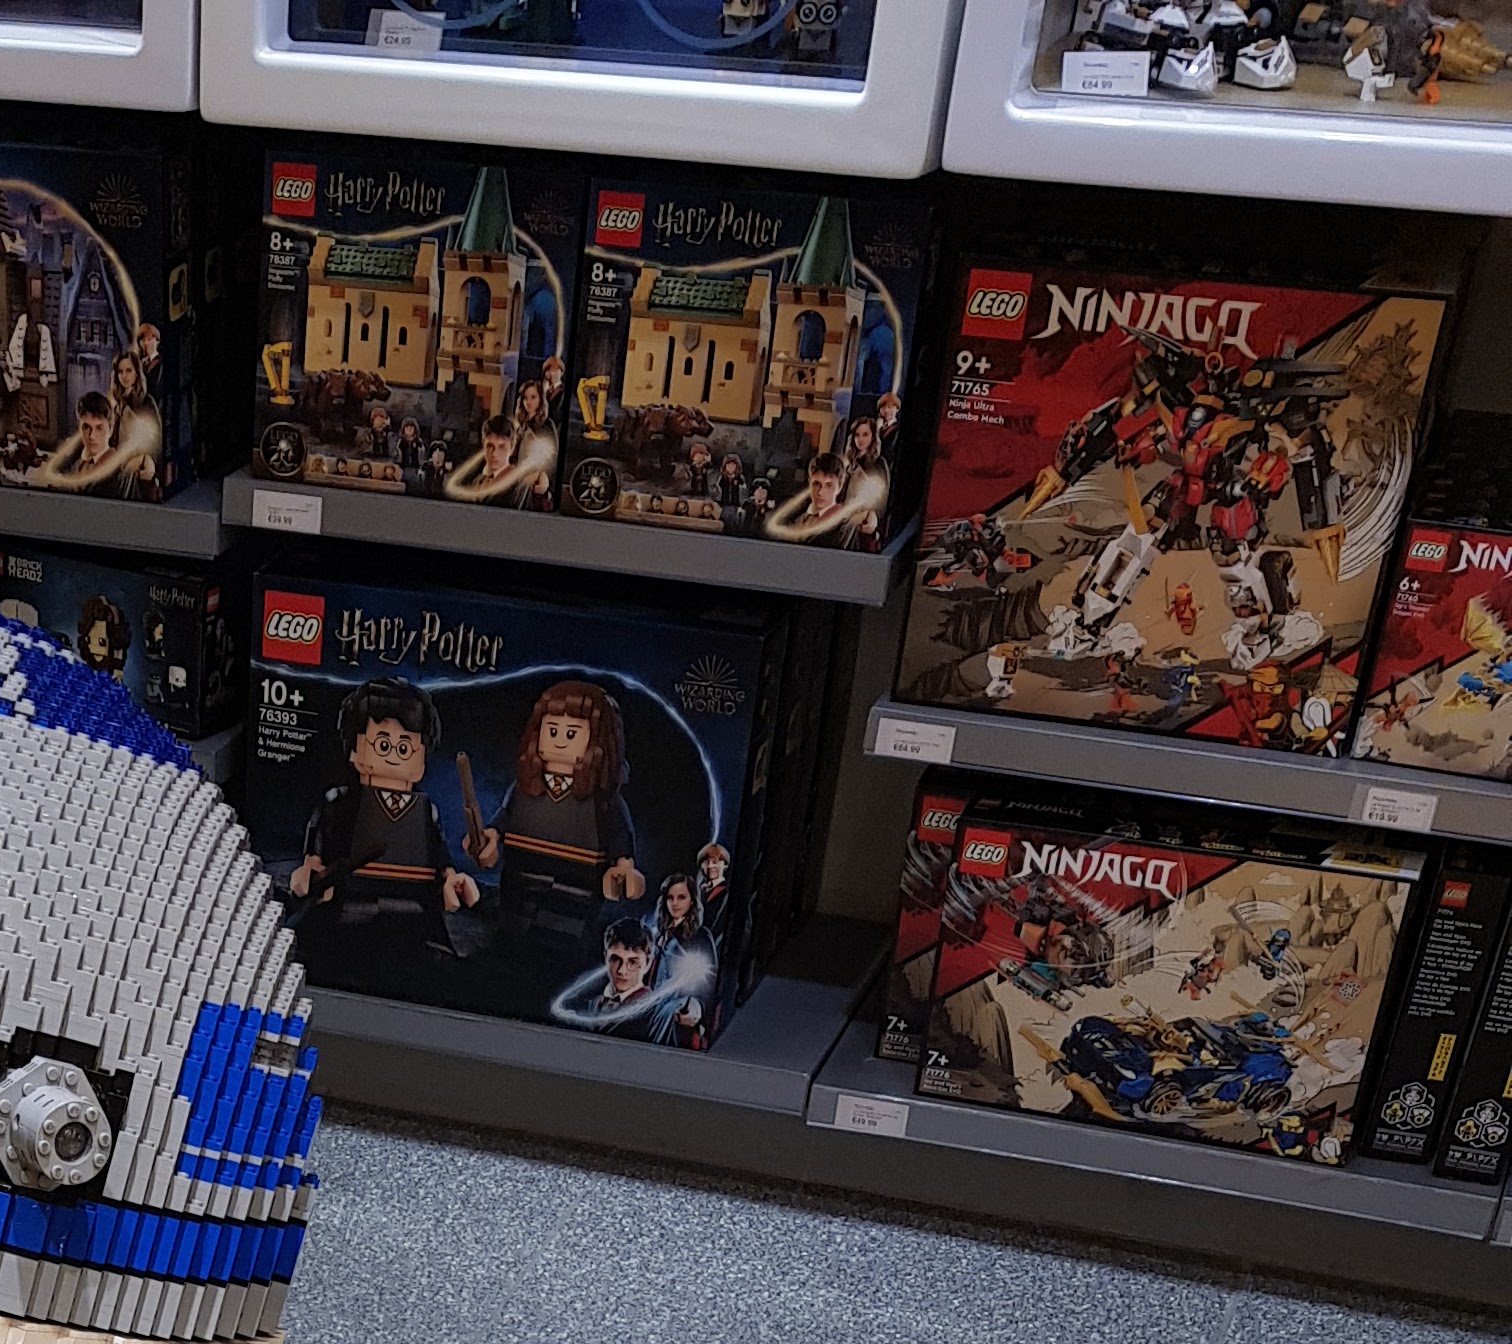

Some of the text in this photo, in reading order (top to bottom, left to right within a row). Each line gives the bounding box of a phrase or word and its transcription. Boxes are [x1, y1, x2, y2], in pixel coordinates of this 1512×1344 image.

[275, 178, 314, 200] LEGO
[324, 171, 445, 217] Harry Potter
[599, 207, 641, 230] LEGO
[652, 201, 782, 247] Harry Potter
[270, 232, 294, 251] 8+
[591, 263, 617, 283] 8+
[966, 289, 1026, 319] LEGO
[1030, 284, 1267, 360] NINJAGO
[955, 351, 991, 375] 9+
[951, 381, 989, 396] 71765
[1410, 542, 1446, 560] LEGO
[16, 557, 43, 571] BRICK
[8, 566, 43, 583] HEADZ
[1399, 577, 1421, 591] 6+
[266, 611, 321, 643] LEGO
[336, 608, 504, 672] Harry Potter
[261, 679, 304, 707] 10+
[674, 682, 746, 702] WIZARDING
[682, 696, 737, 715] WORLD
[259, 708, 298, 726] 76393
[258, 725, 281, 739] Harry
[1006, 799, 1087, 818] NINJAGO
[965, 841, 1007, 866] LEGO
[1010, 841, 1179, 901] NINJAGO
[887, 1015, 908, 1031] 7+
[928, 1050, 949, 1066] 7+
